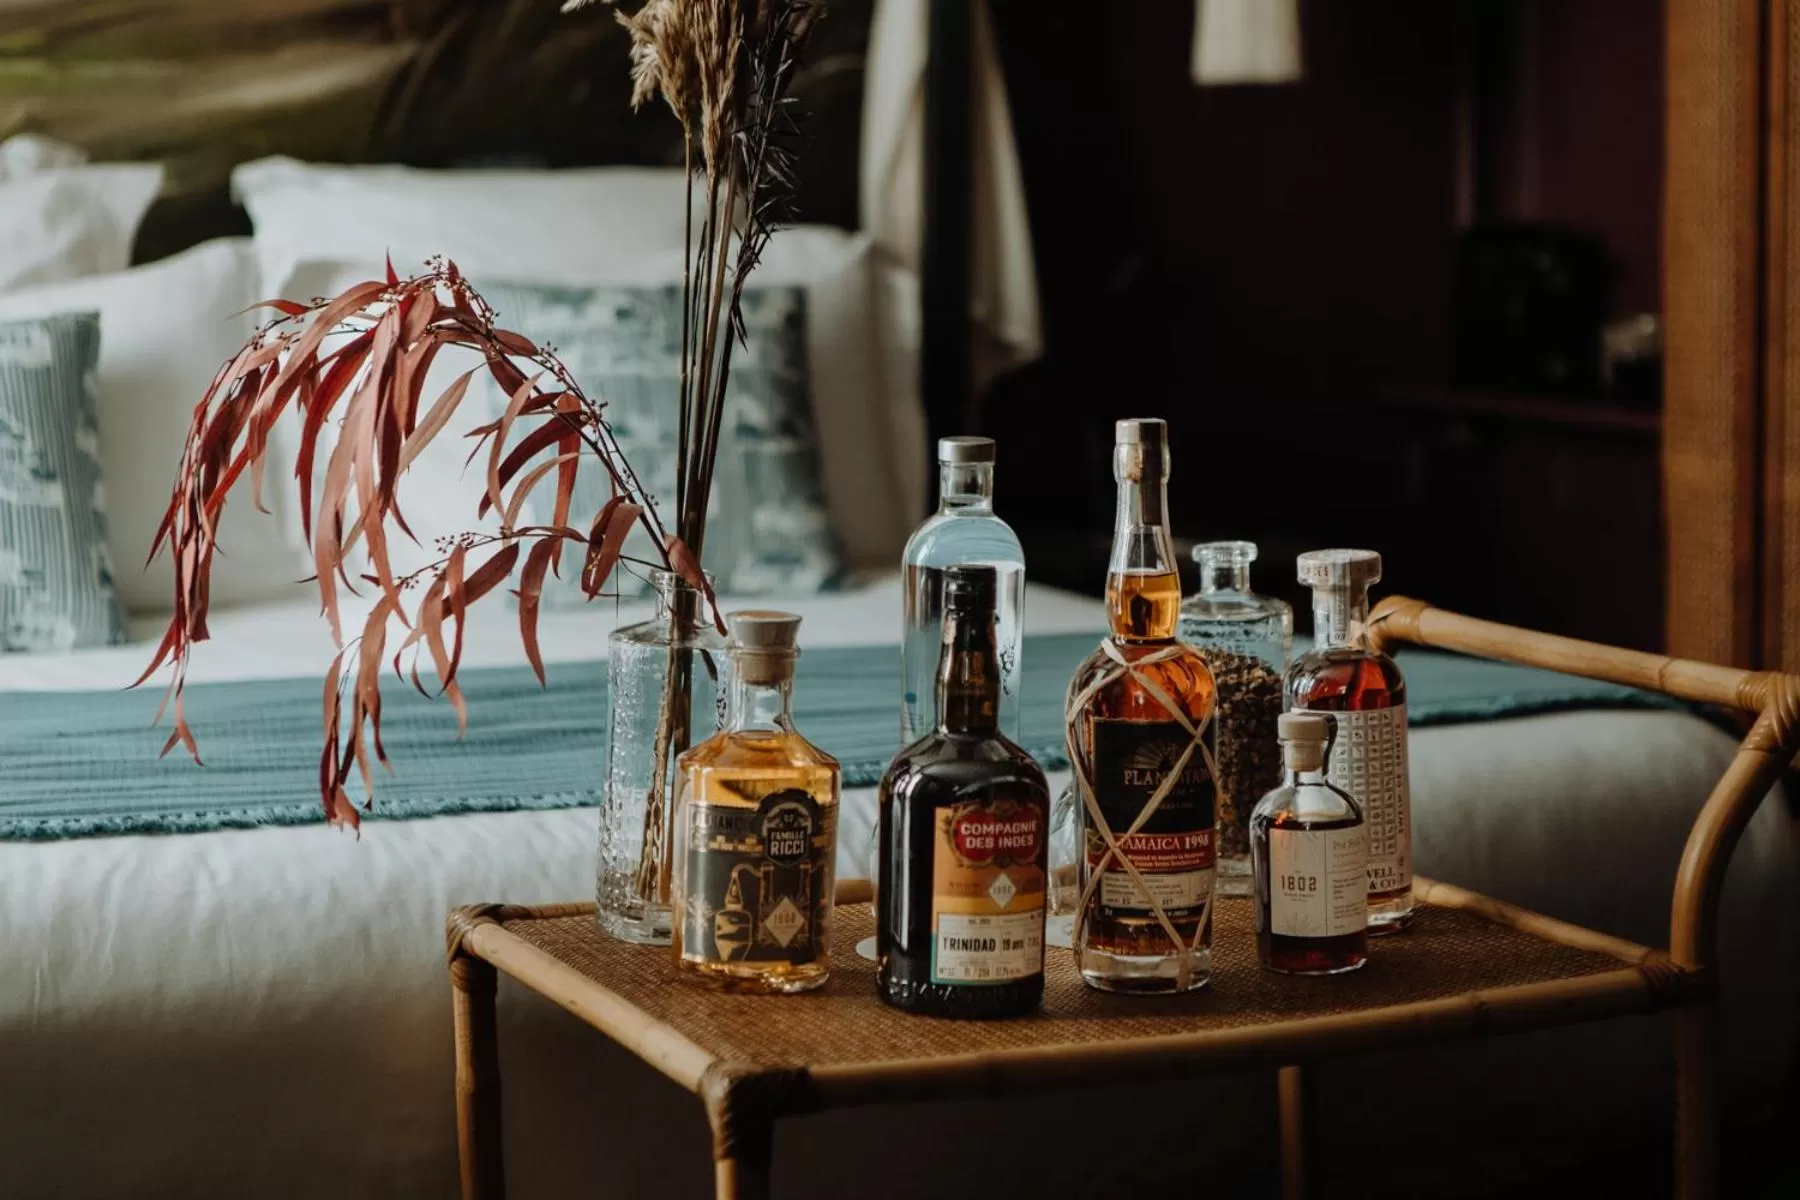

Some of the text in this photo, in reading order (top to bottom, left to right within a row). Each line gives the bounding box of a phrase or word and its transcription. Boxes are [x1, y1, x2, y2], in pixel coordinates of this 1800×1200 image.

[770, 830, 805, 840] FAMILLE
[961, 820, 1037, 835] COMPAGNIE
[770, 840, 805, 856] RICCI
[966, 834, 1034, 849] DES INDES
[1281, 874, 1317, 891] 1802
[943, 937, 996, 953] TRINIDAD
